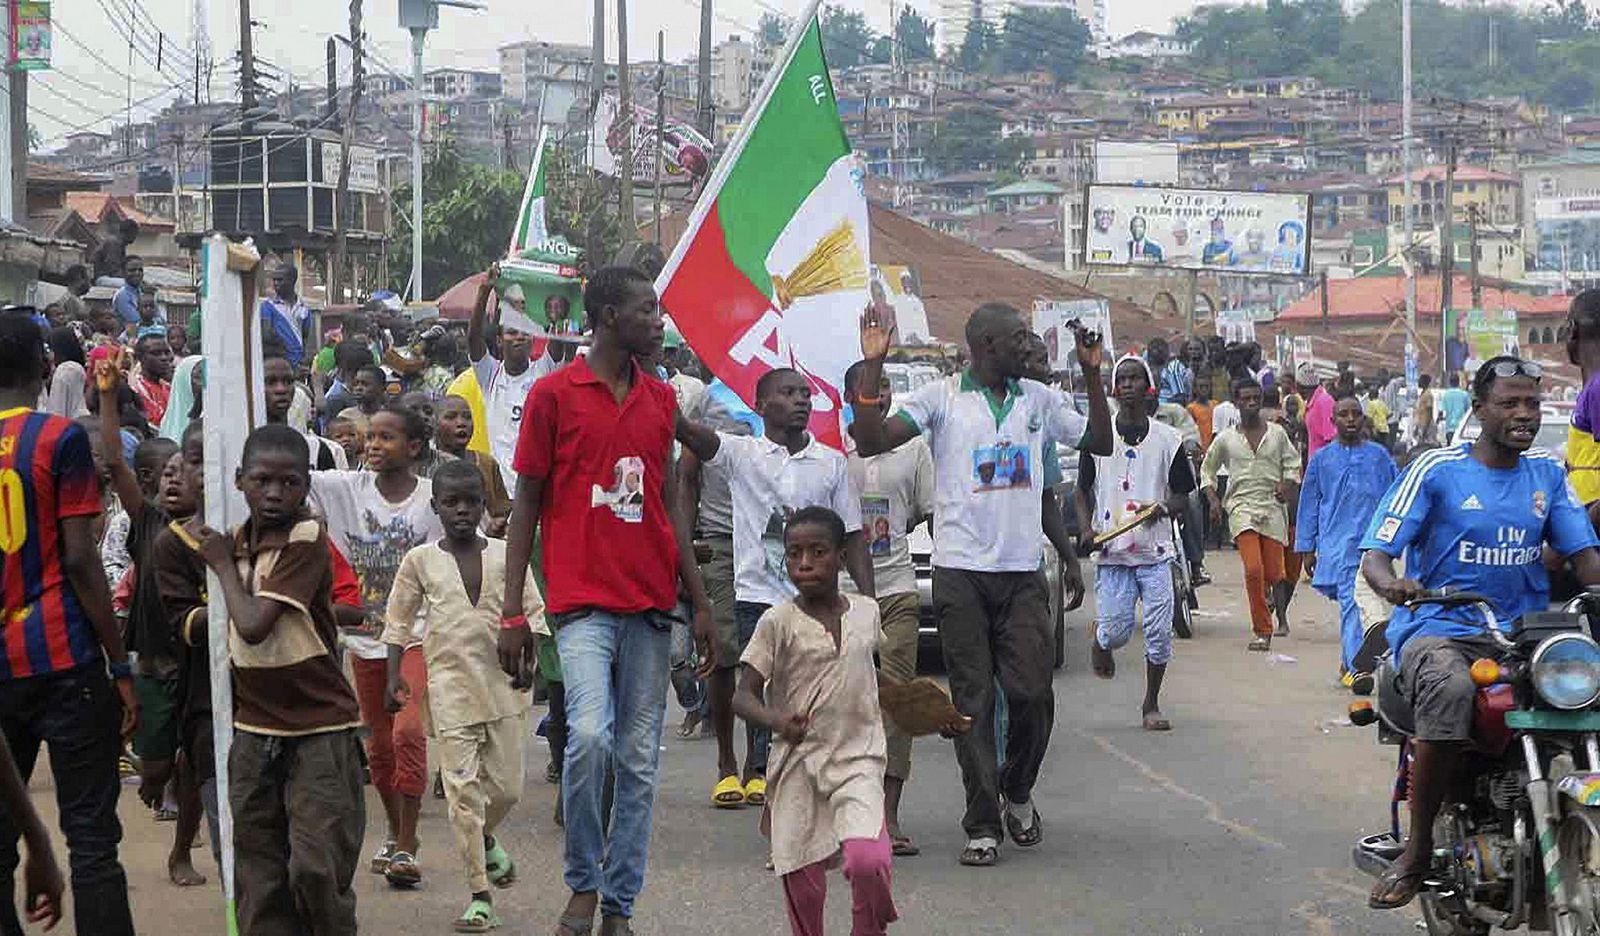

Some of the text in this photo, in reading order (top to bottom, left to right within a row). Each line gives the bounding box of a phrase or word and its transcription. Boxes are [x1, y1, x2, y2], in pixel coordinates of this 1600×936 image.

[808, 74, 826, 106] ALL
[1161, 194, 1203, 206] Vote
[1134, 205, 1263, 218] TEAM FOR CHANGE
